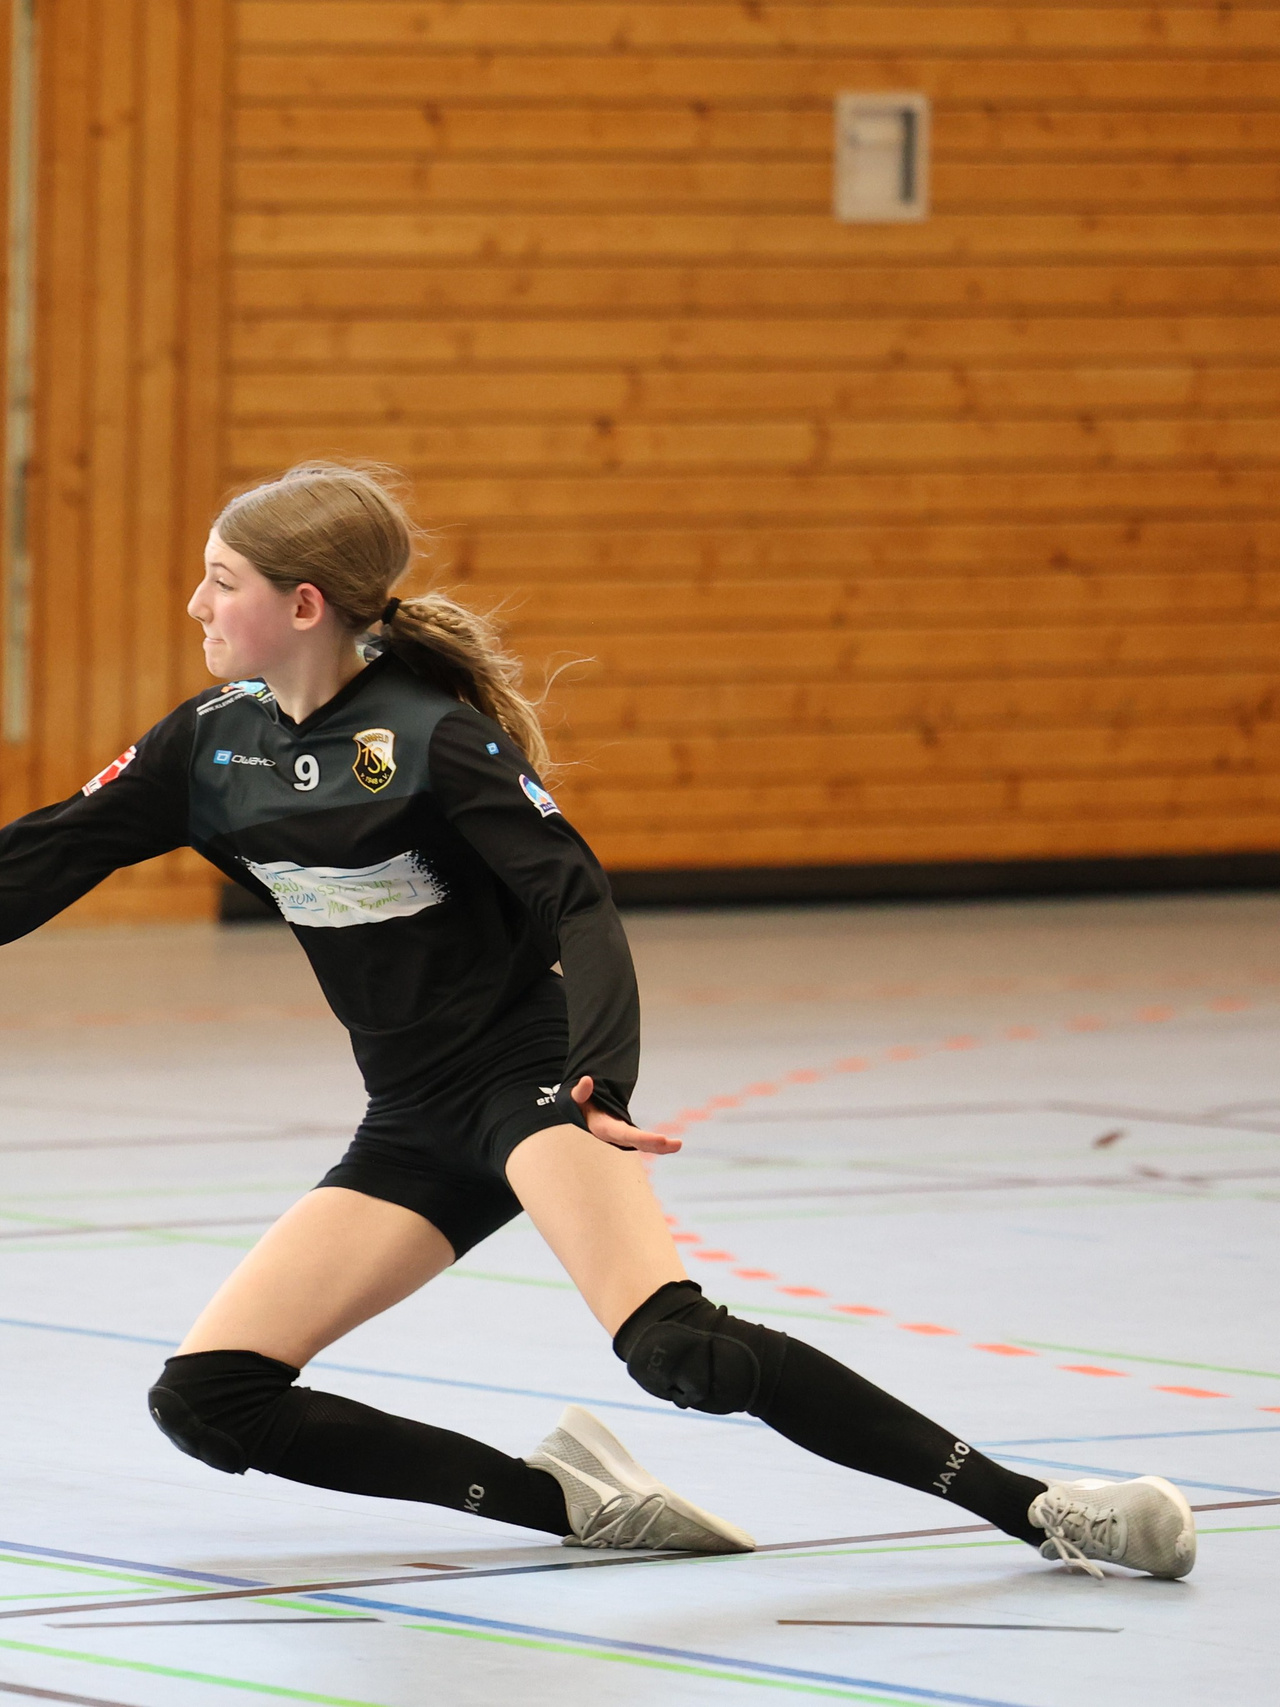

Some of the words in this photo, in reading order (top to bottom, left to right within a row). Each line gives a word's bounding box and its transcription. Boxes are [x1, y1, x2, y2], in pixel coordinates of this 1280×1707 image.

[293, 754, 320, 791] 9
[361, 743, 391, 774] TSV
[932, 1441, 971, 1494] JAKO
